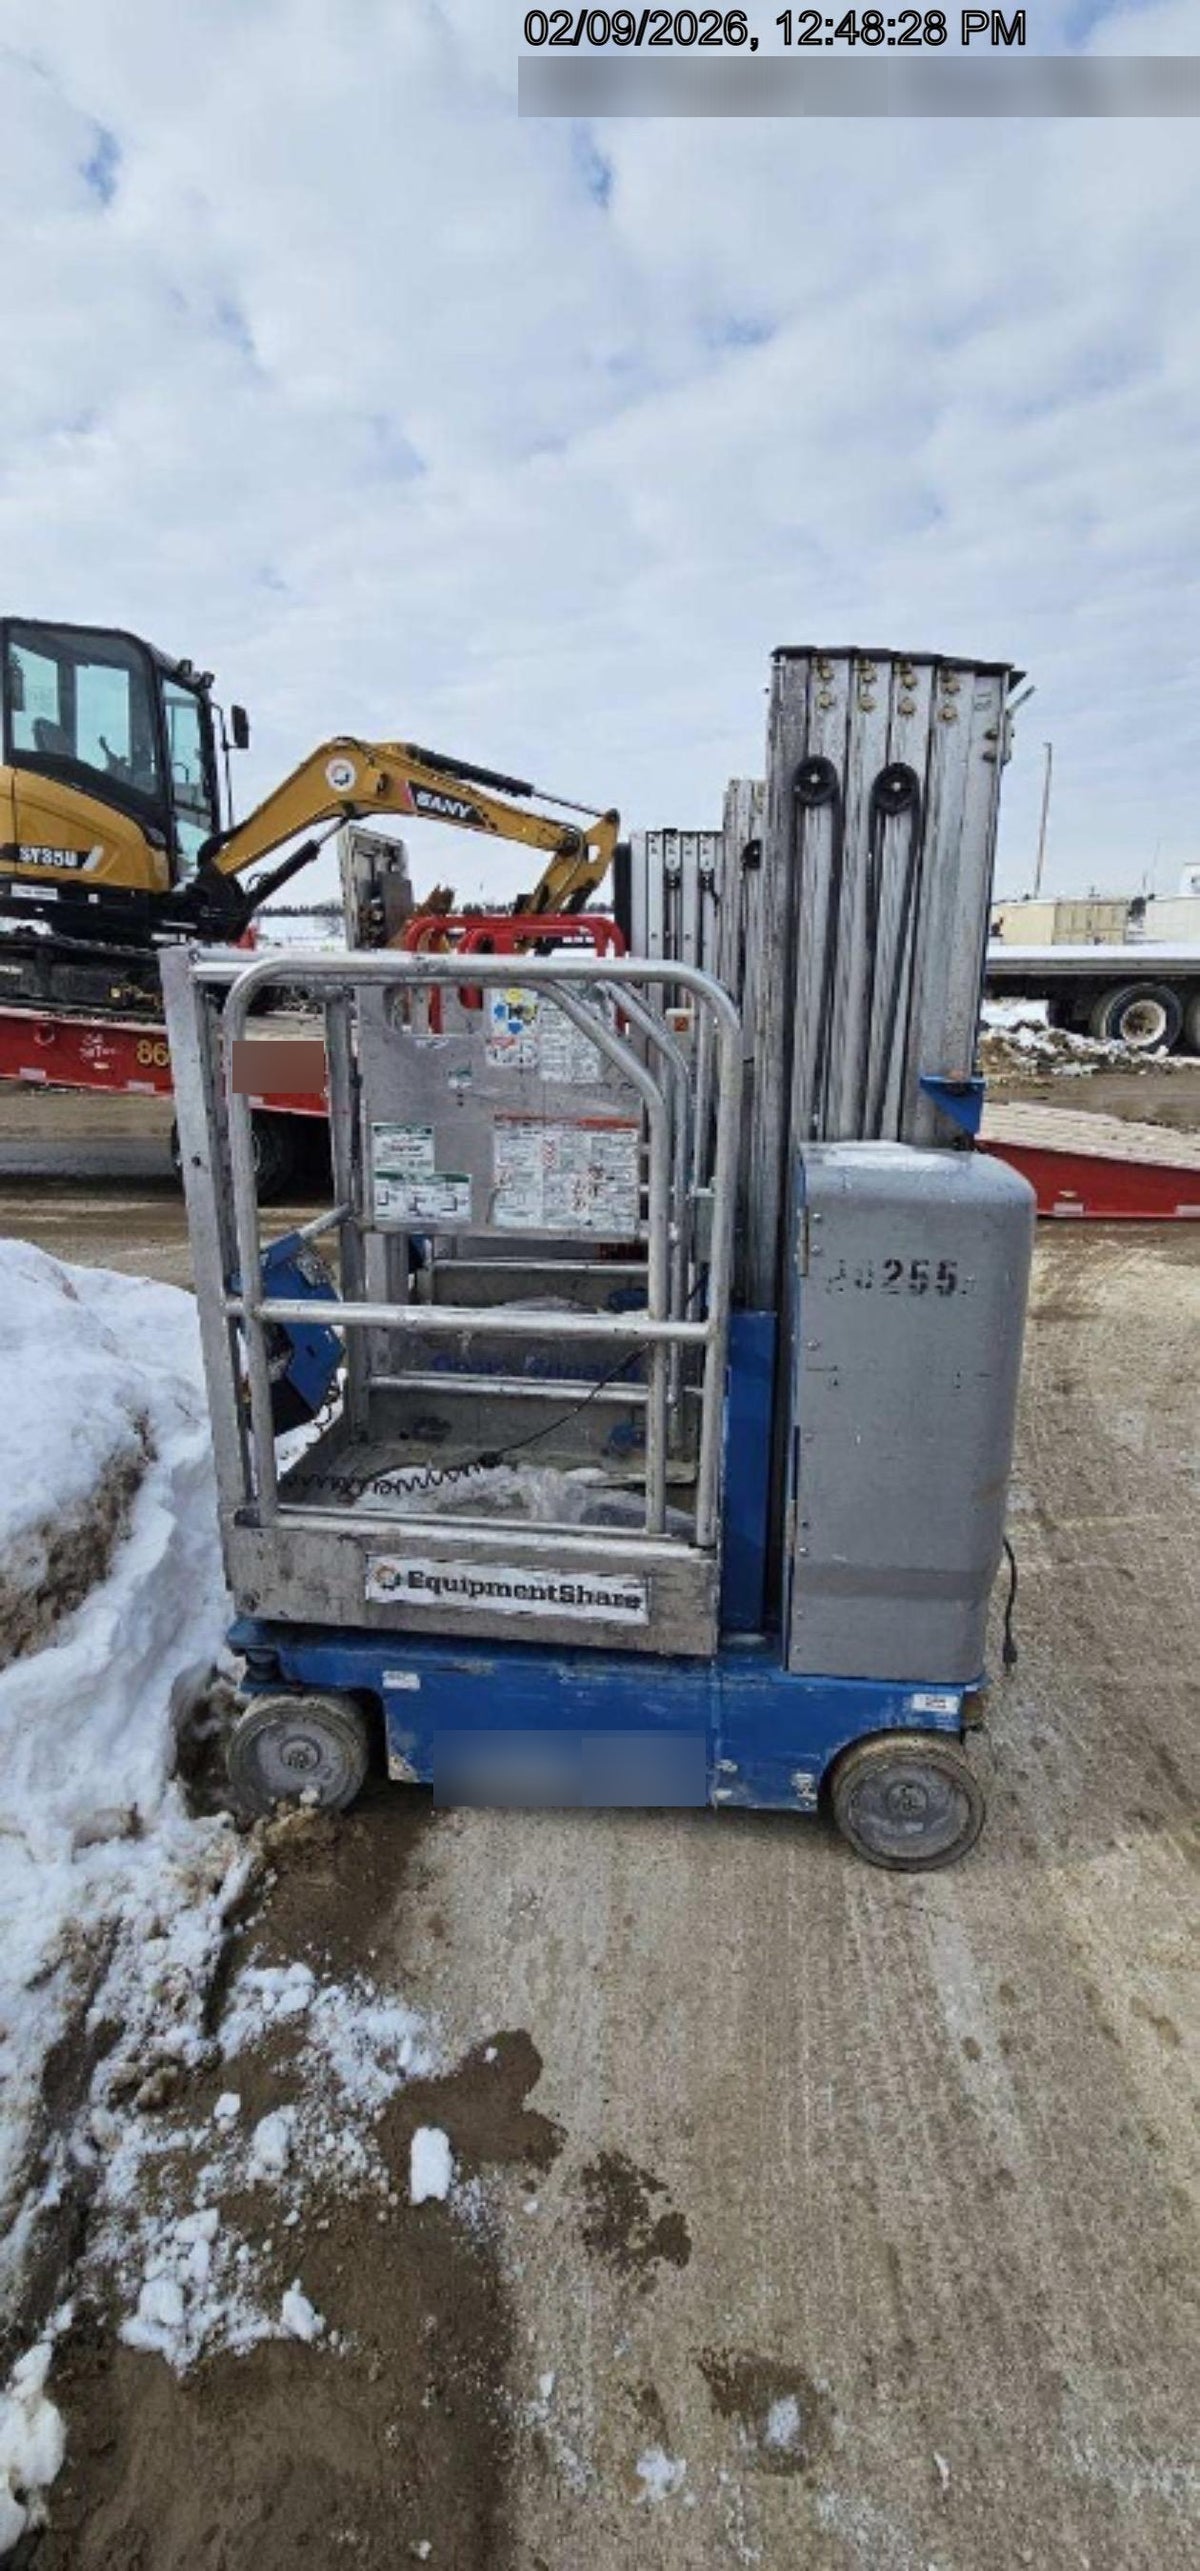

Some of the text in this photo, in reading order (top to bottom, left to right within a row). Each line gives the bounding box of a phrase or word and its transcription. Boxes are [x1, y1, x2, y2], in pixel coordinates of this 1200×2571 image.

[416, 791, 473, 819] SANY
[19, 846, 78, 867] SY35U
[407, 1569, 642, 1610] EquipmentShare
